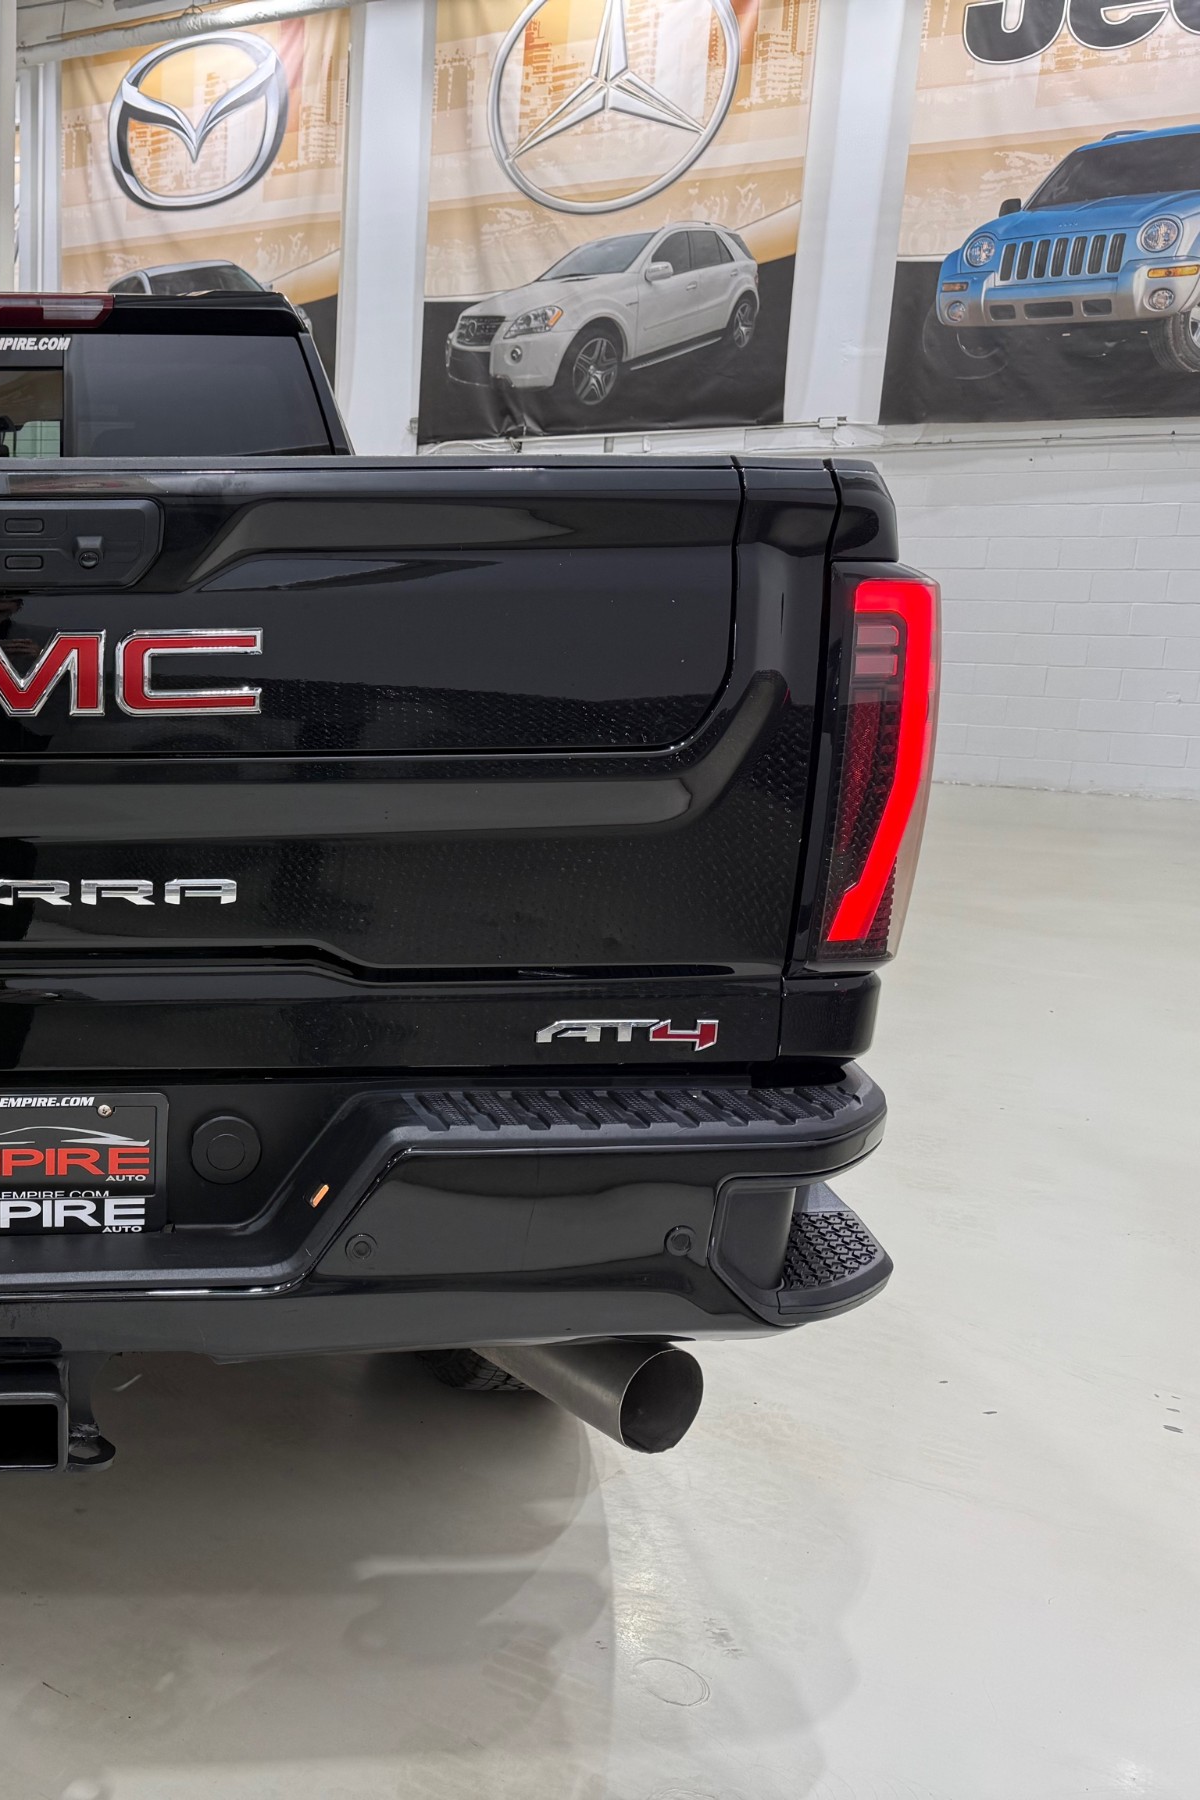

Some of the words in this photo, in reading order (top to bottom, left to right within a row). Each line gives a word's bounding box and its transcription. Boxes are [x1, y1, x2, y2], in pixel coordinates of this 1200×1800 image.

[963, 0, 1200, 65] Je
[536, 1019, 719, 1051] AT4
[105, 1174, 146, 1182] AUTO
[102, 1225, 142, 1233] AUTO
